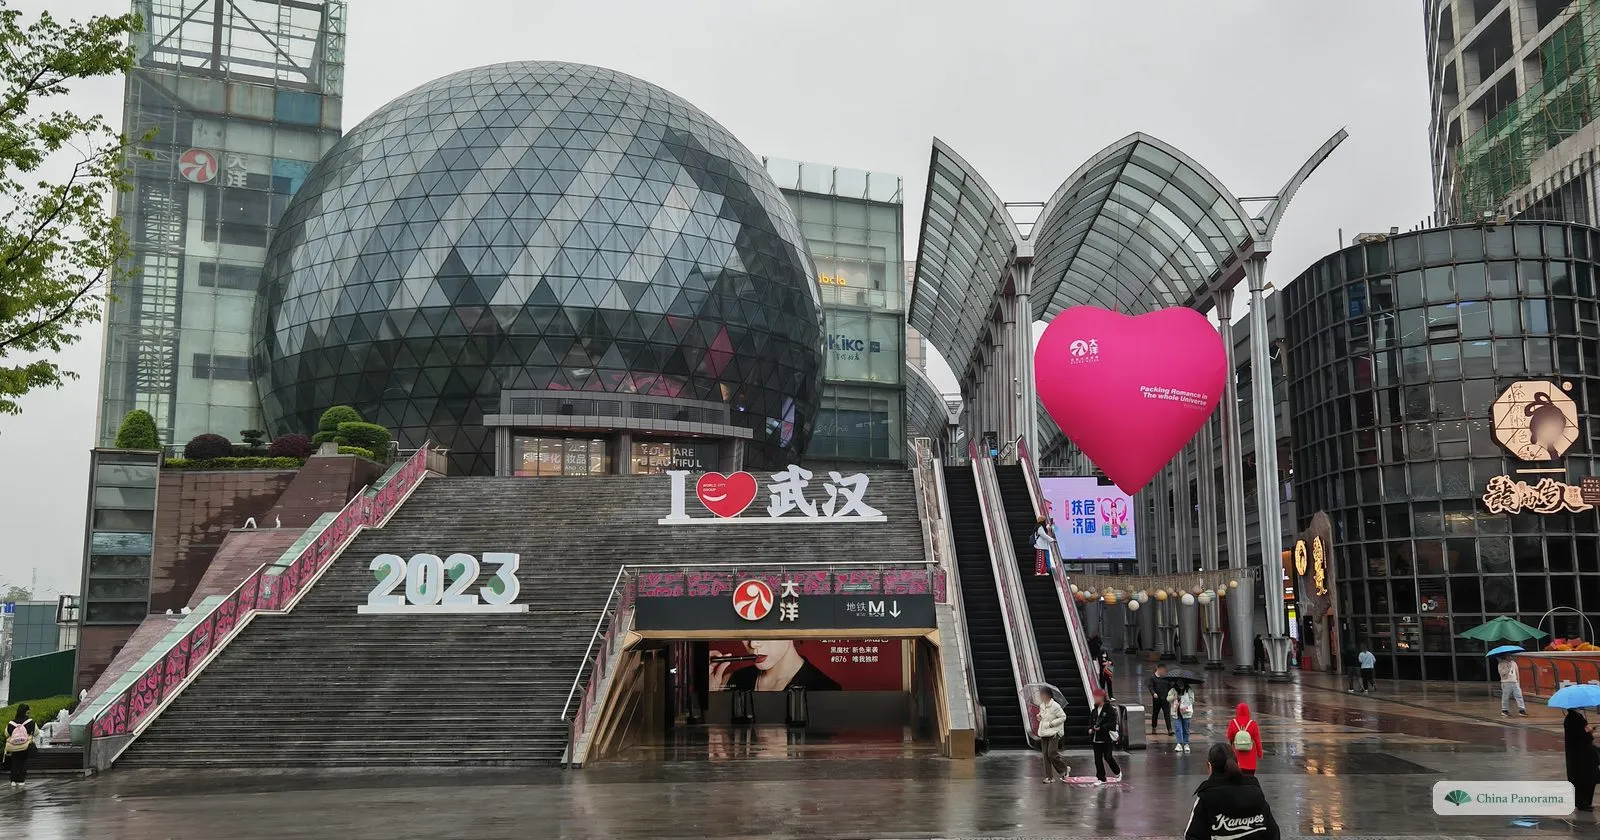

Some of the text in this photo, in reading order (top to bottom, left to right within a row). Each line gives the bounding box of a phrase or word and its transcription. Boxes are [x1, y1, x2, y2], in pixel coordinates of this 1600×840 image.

[1140, 385, 1170, 395] Packing
[1171, 388, 1202, 398] Romance
[1180, 395, 1207, 406] Universe
[675, 447, 694, 457] ARE
[665, 464, 883, 519] I 武汉
[1071, 500, 1096, 515] 扶危
[1072, 518, 1097, 534] 济困
[368, 552, 520, 606] 2023
[779, 580, 799, 622] 大洋
[846, 602, 867, 613] 地铁
[830, 655, 847, 663] #876
